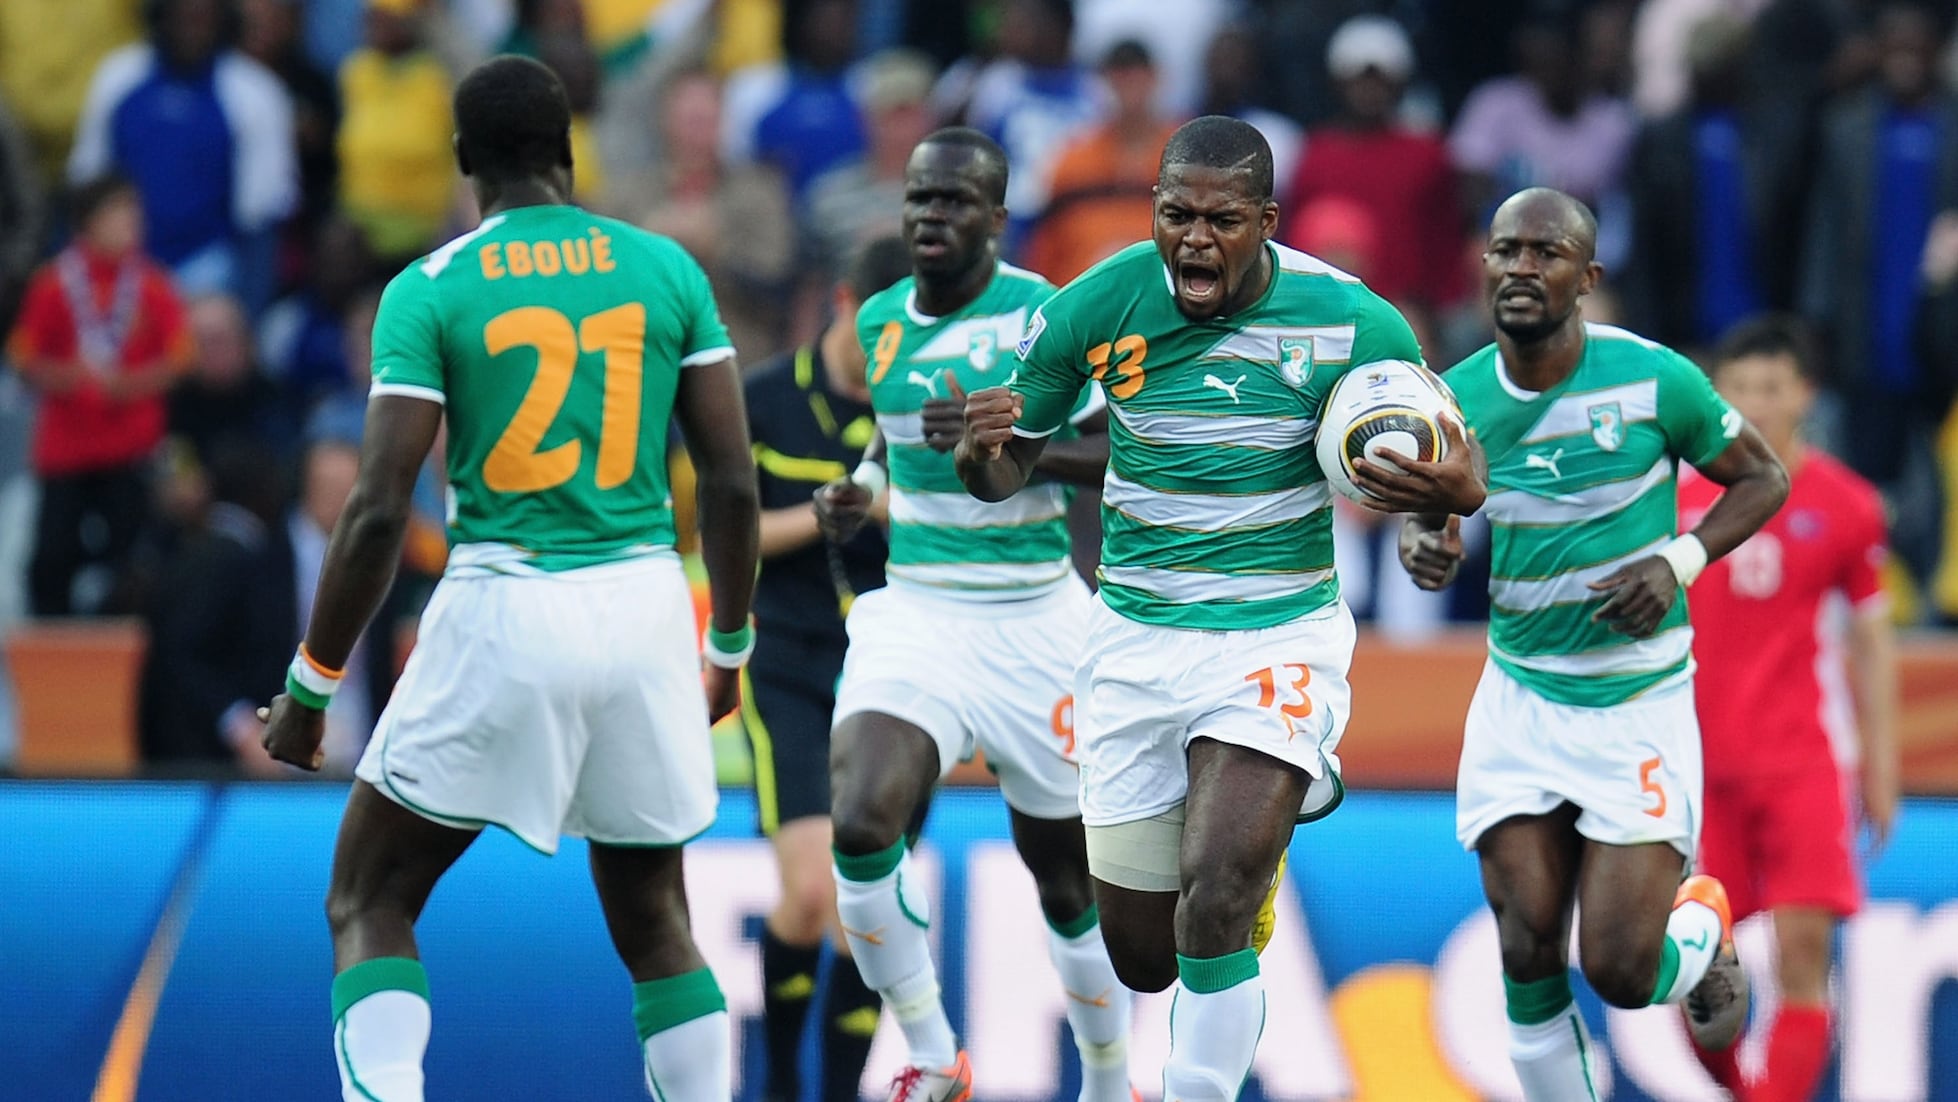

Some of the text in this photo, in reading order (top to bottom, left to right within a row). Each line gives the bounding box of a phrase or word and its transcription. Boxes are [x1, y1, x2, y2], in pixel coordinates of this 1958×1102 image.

[871, 321, 903, 384] 9
[1086, 333, 1148, 399] 13
[482, 302, 647, 494] 21
[1243, 662, 1313, 719] 13
[1638, 756, 1667, 819] 5
